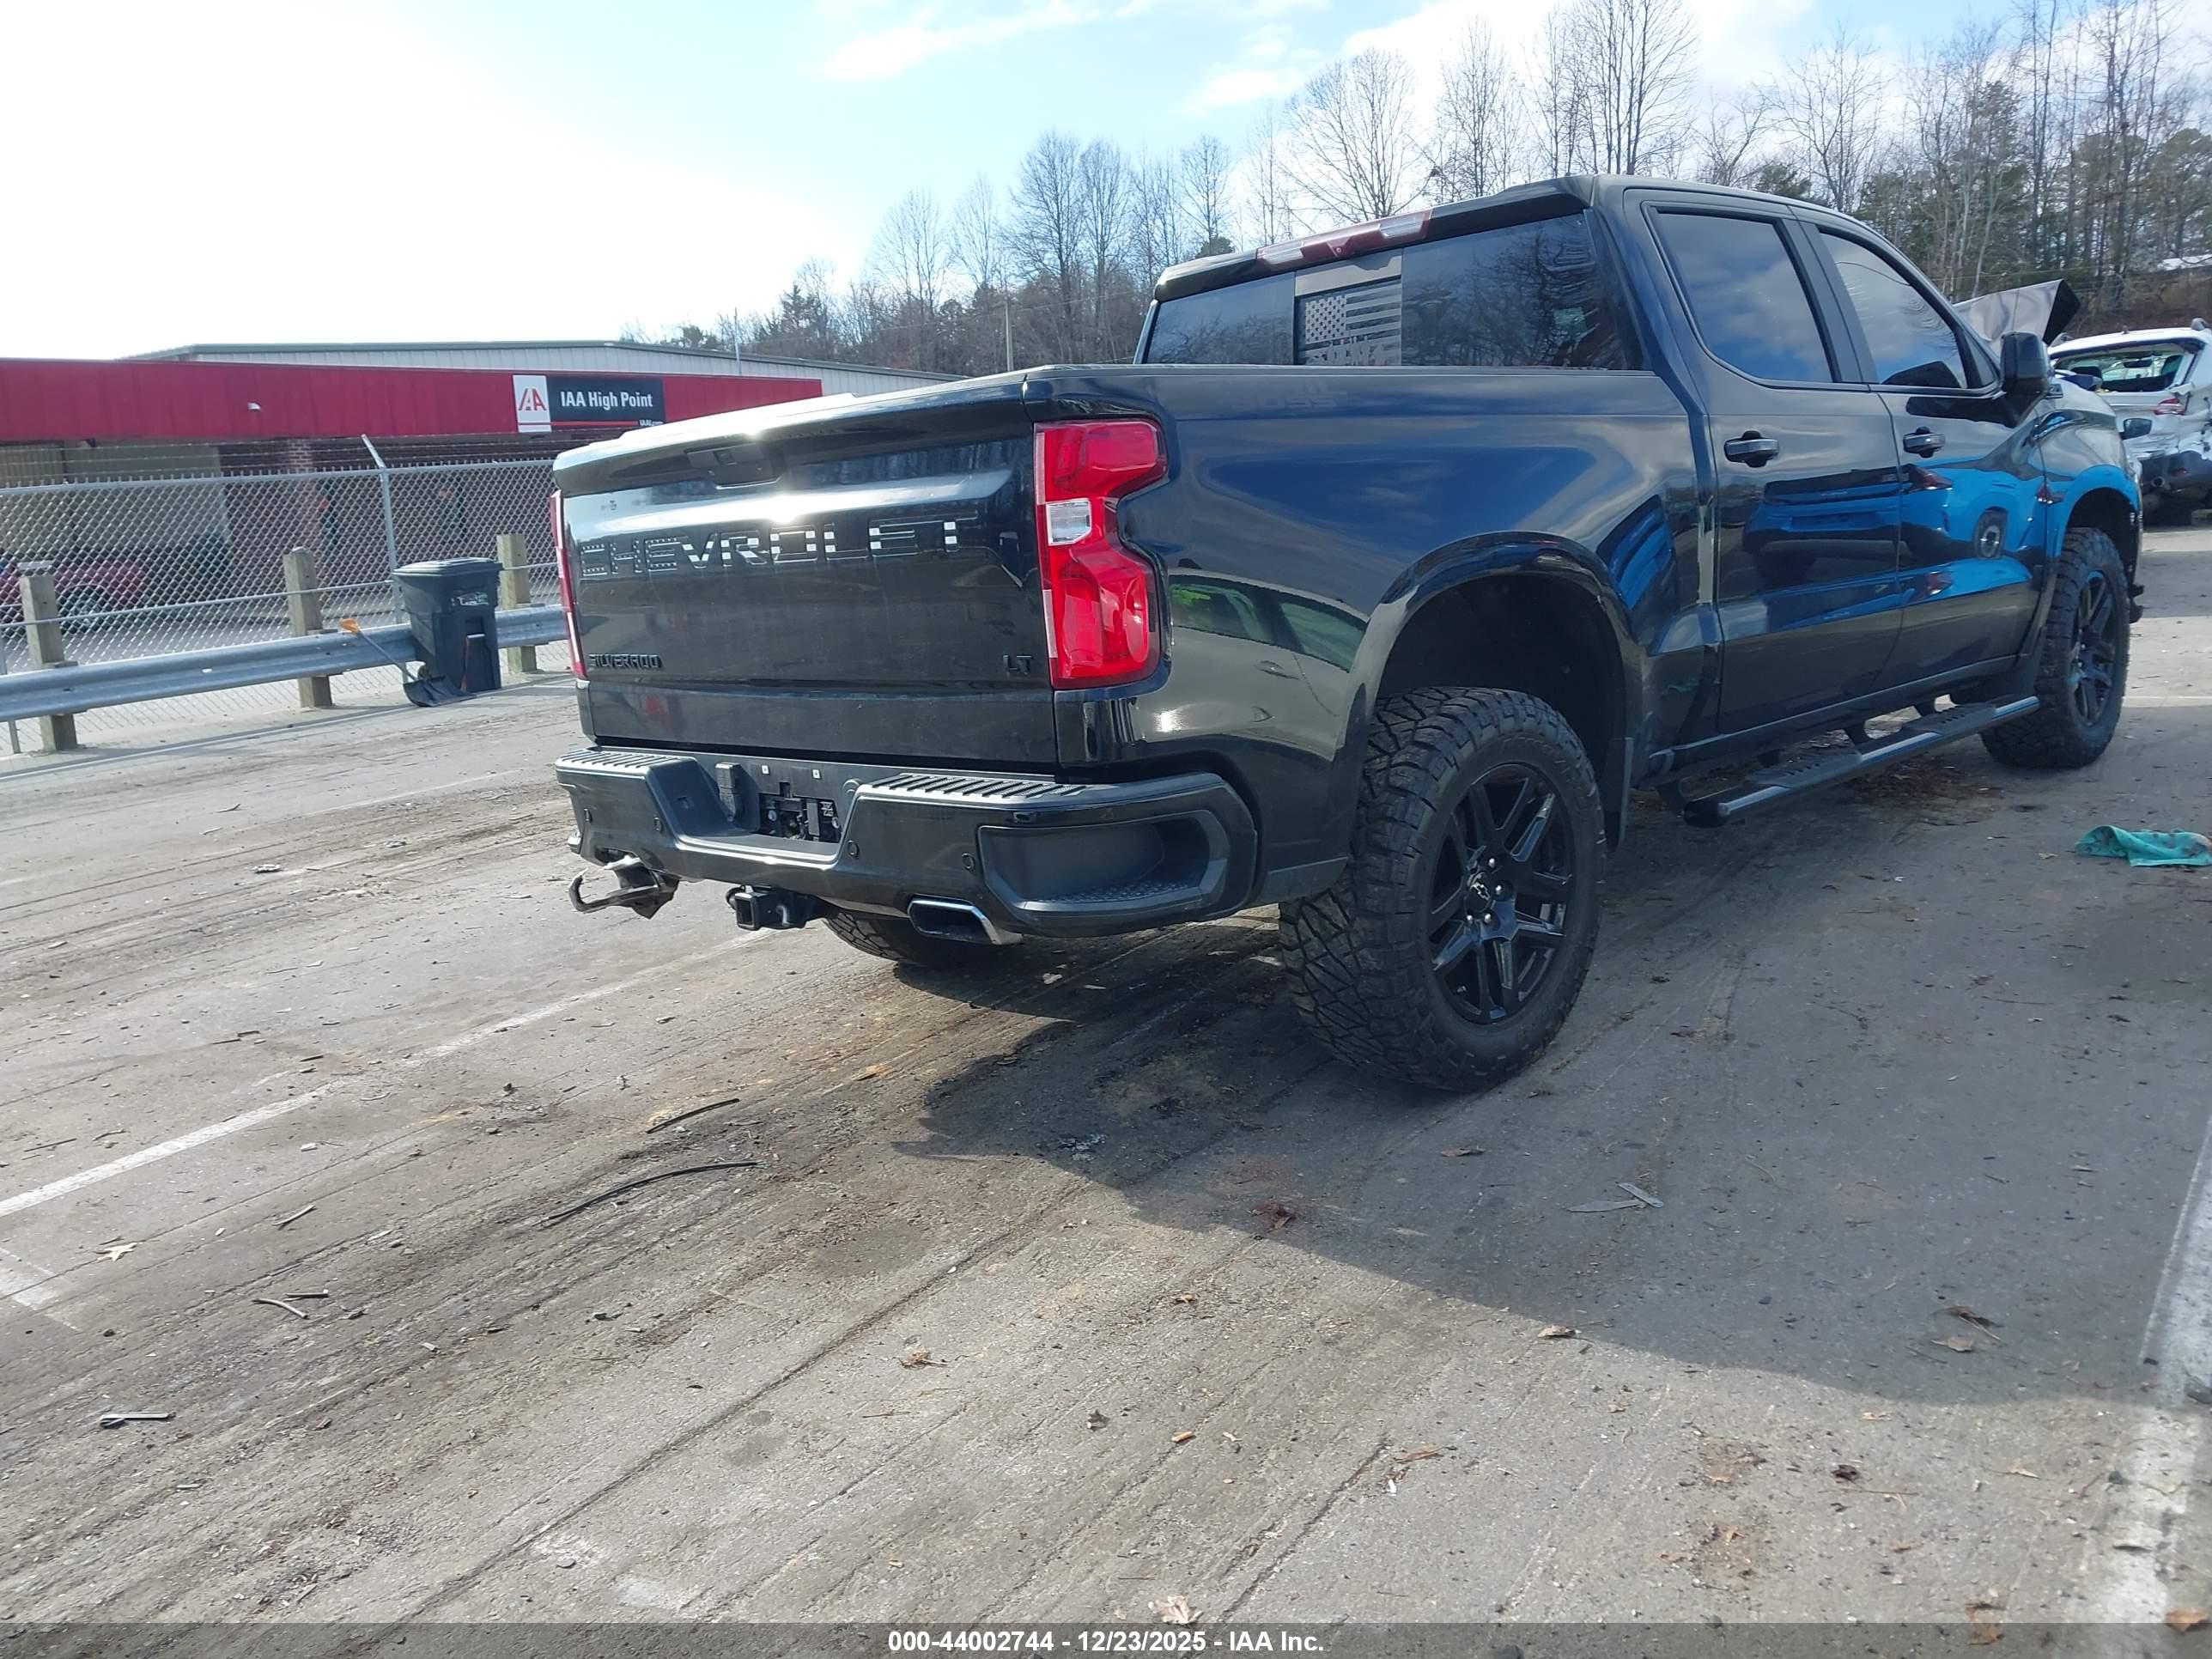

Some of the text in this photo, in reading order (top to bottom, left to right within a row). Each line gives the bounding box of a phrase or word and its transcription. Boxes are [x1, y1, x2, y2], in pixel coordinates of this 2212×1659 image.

[560, 391, 653, 411] IAA High Point
[580, 509, 979, 579] CHEVROLET
[587, 653, 663, 669] SILVERADO
[1002, 654, 1032, 675] LT
